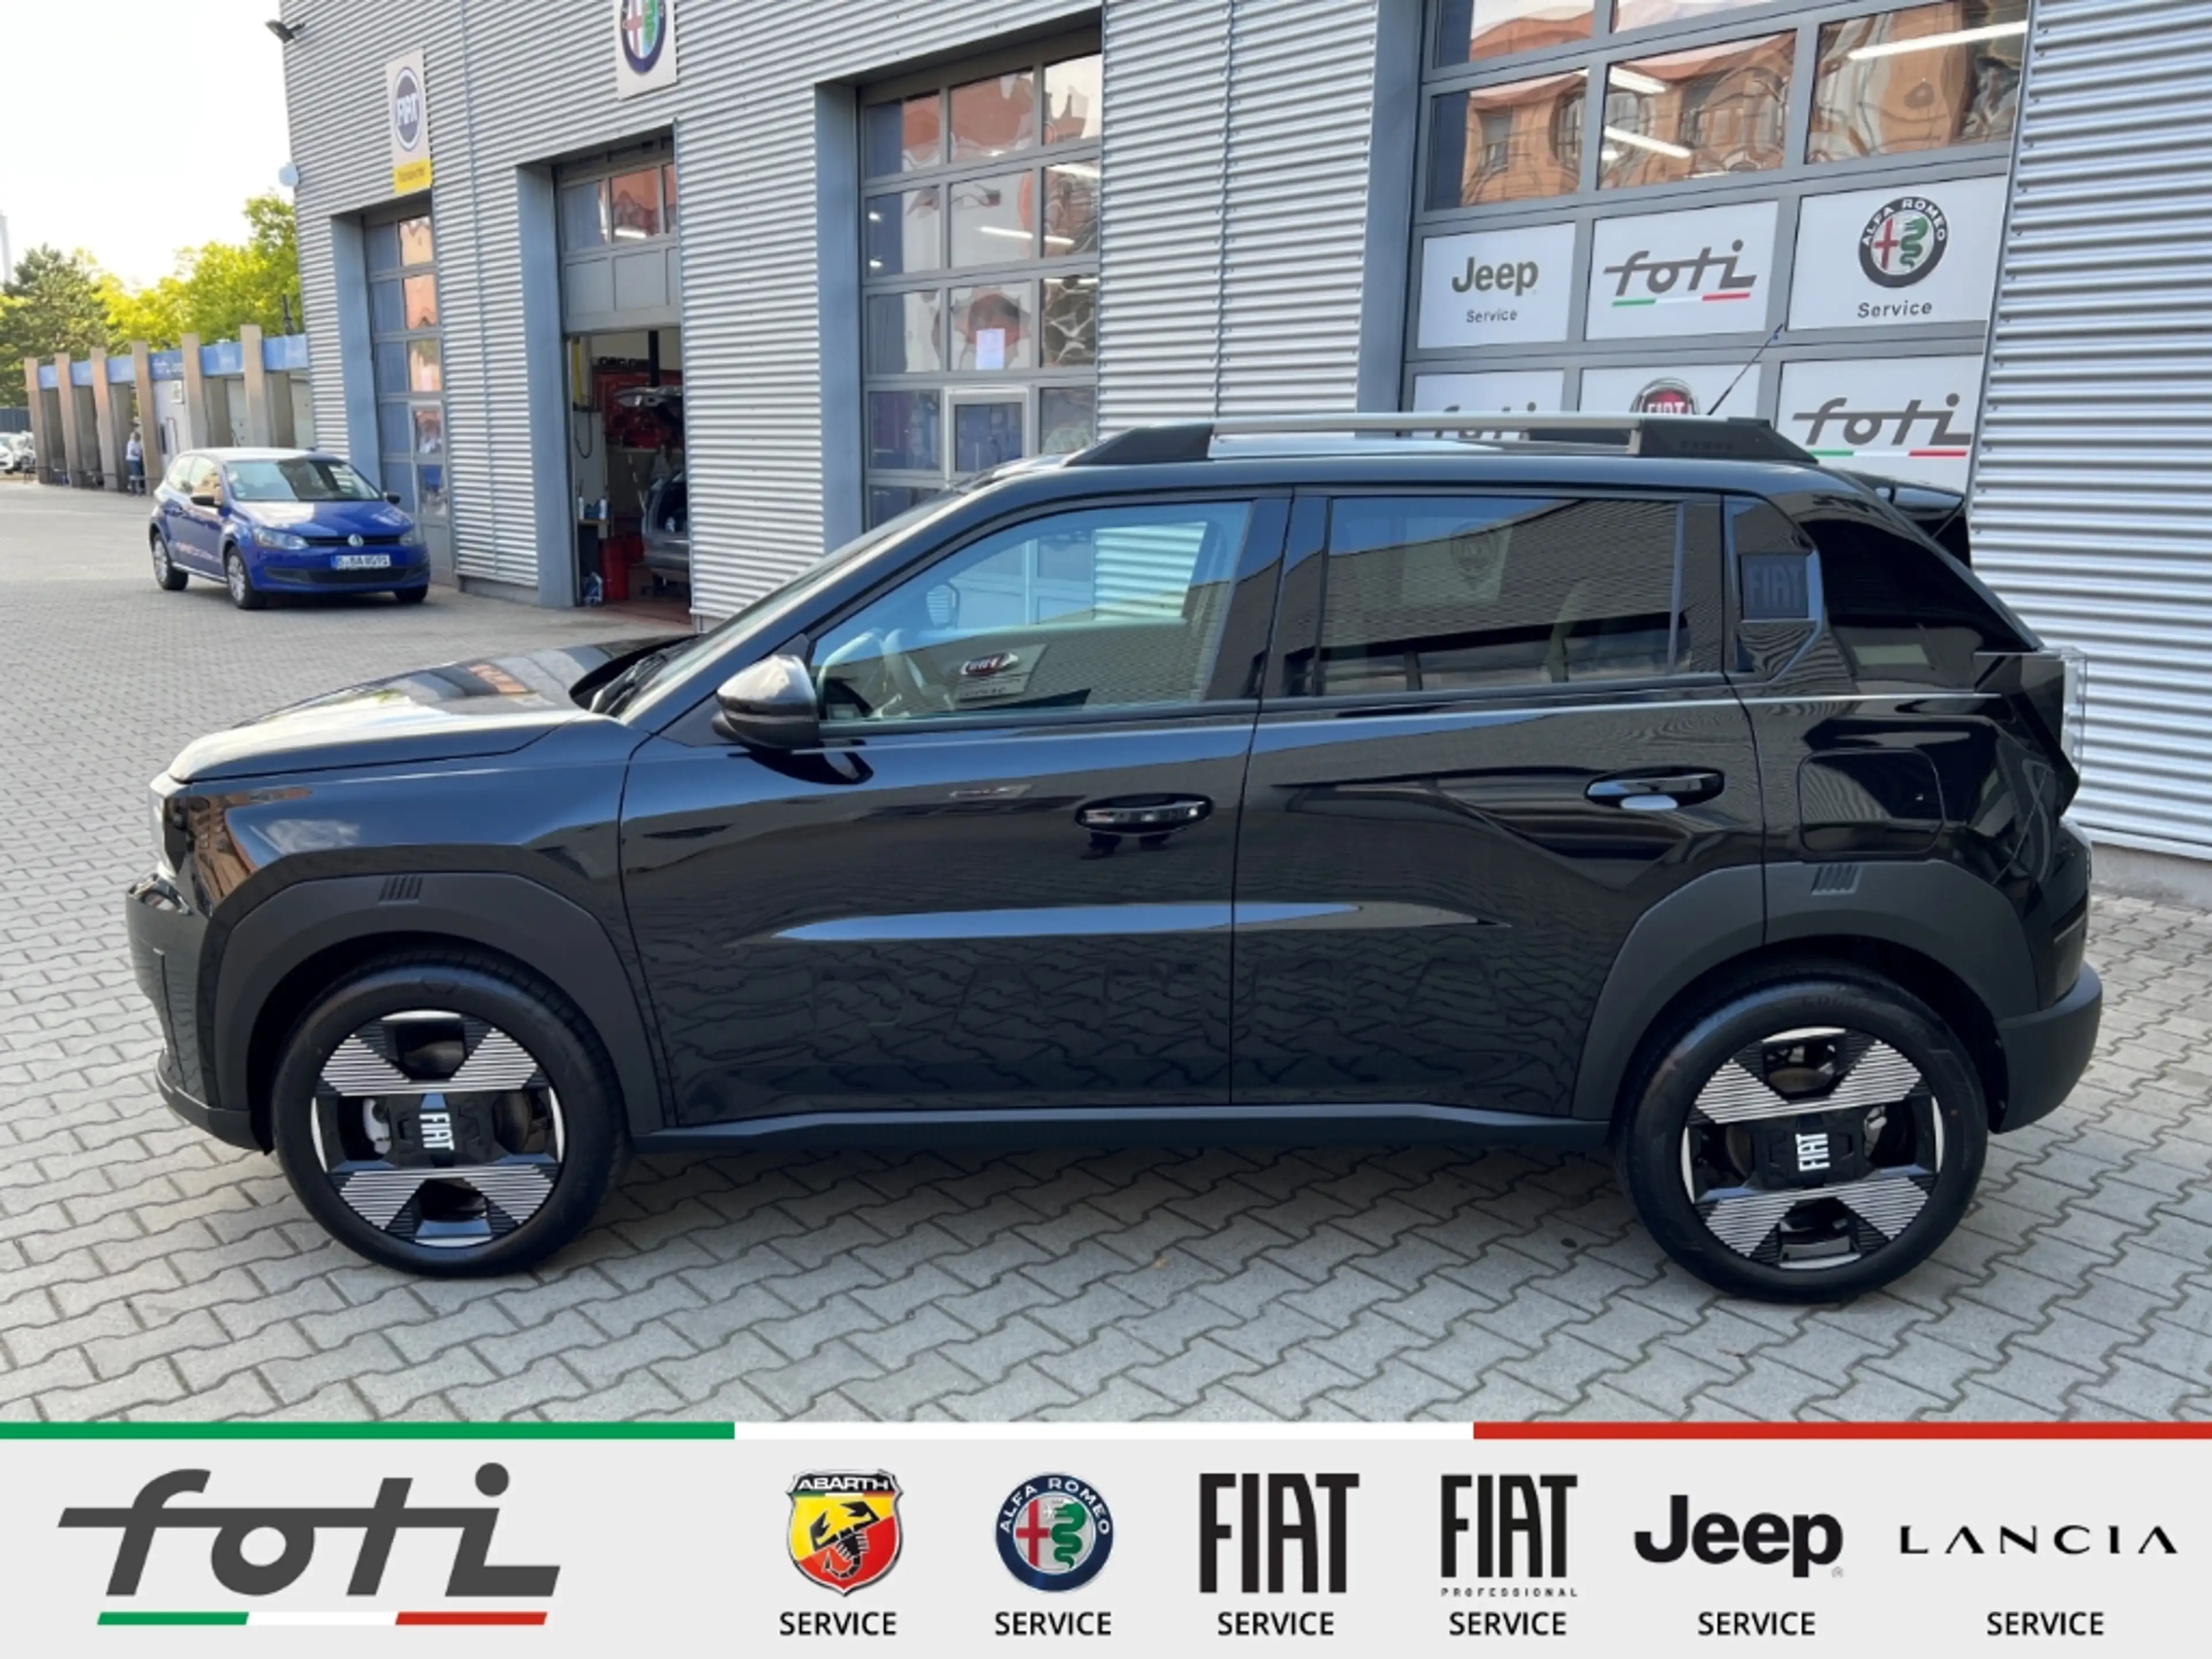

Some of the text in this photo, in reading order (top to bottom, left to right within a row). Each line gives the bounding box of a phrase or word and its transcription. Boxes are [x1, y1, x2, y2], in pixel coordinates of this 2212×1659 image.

[1862, 199, 1946, 247] ALFA ROMEO
[1452, 257, 1539, 296] Jeep
[1604, 240, 1756, 297] foti
[1466, 309, 1518, 323] Service
[1858, 300, 1933, 318] Service
[1791, 393, 1972, 446] foti
[1747, 565, 1804, 609] FIAT
[419, 1113, 454, 1150] FIAT
[1795, 1133, 1831, 1172] FIAT
